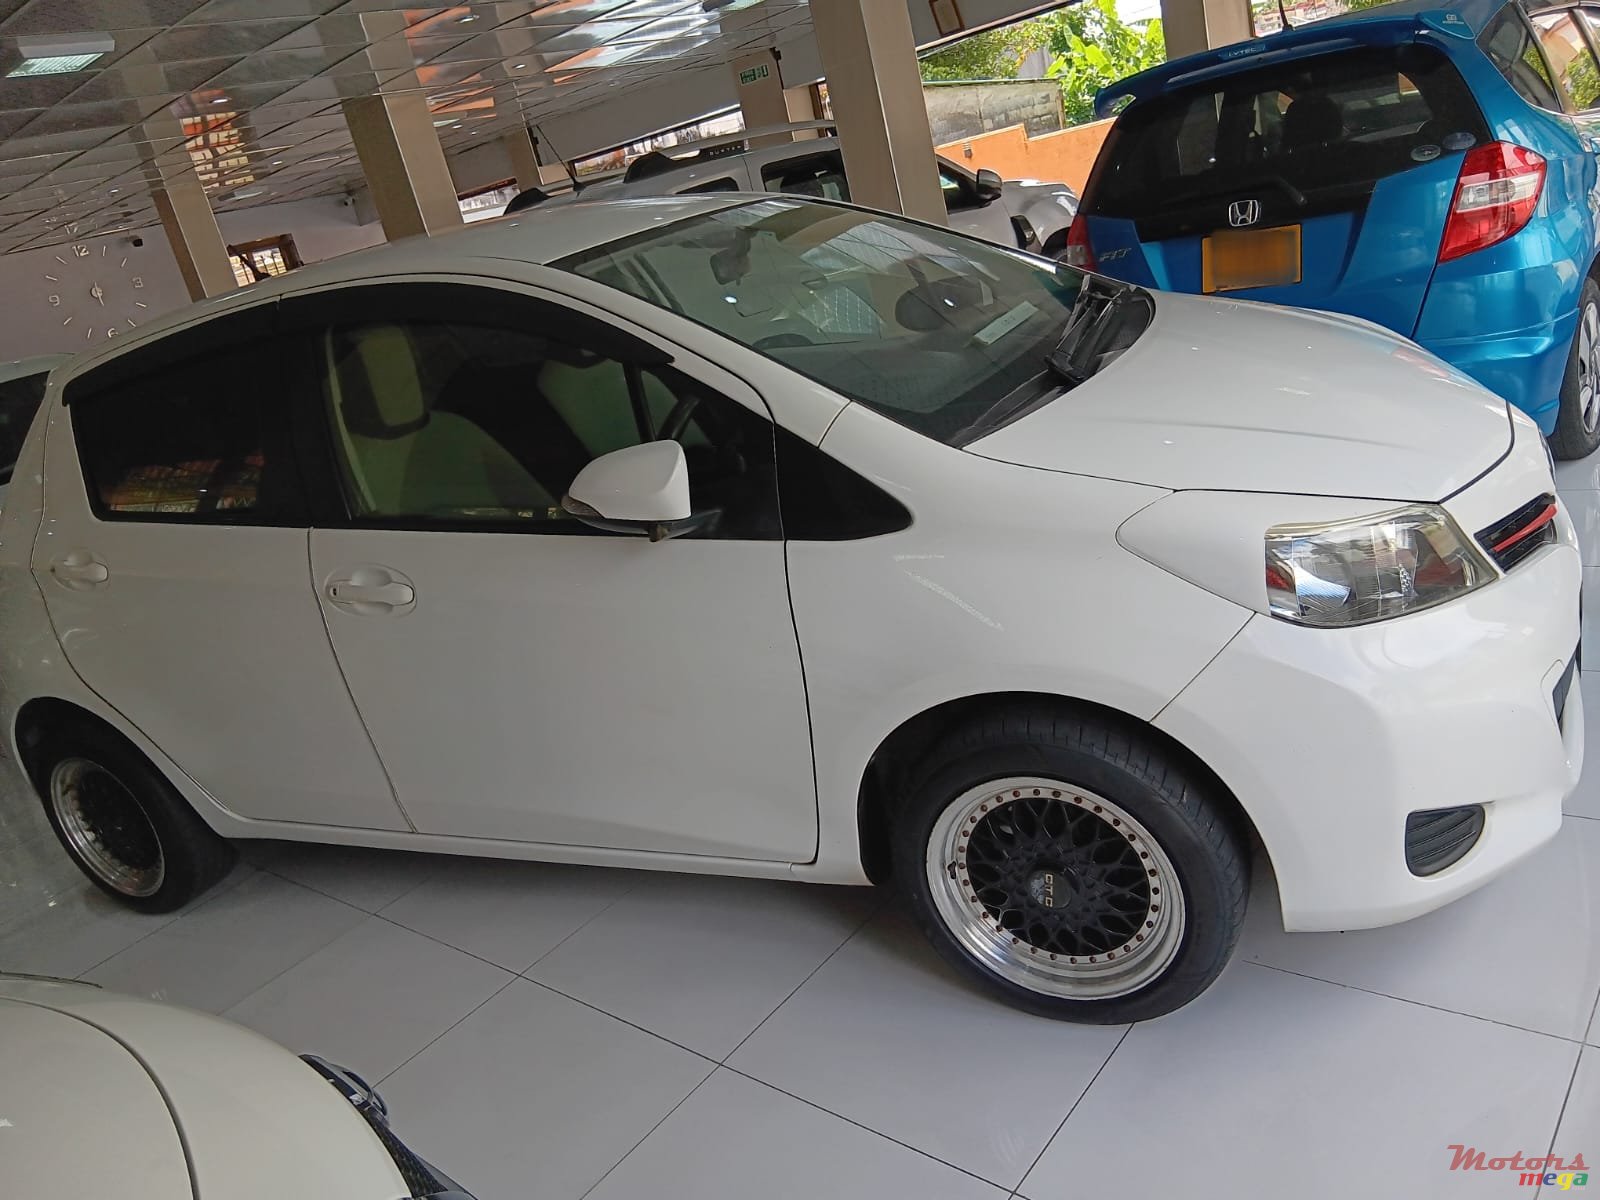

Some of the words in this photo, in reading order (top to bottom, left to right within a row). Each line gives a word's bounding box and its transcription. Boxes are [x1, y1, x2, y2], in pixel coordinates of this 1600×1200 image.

[72, 244, 89, 257] 12
[132, 277, 144, 288] 3
[49, 295, 60, 306] 9
